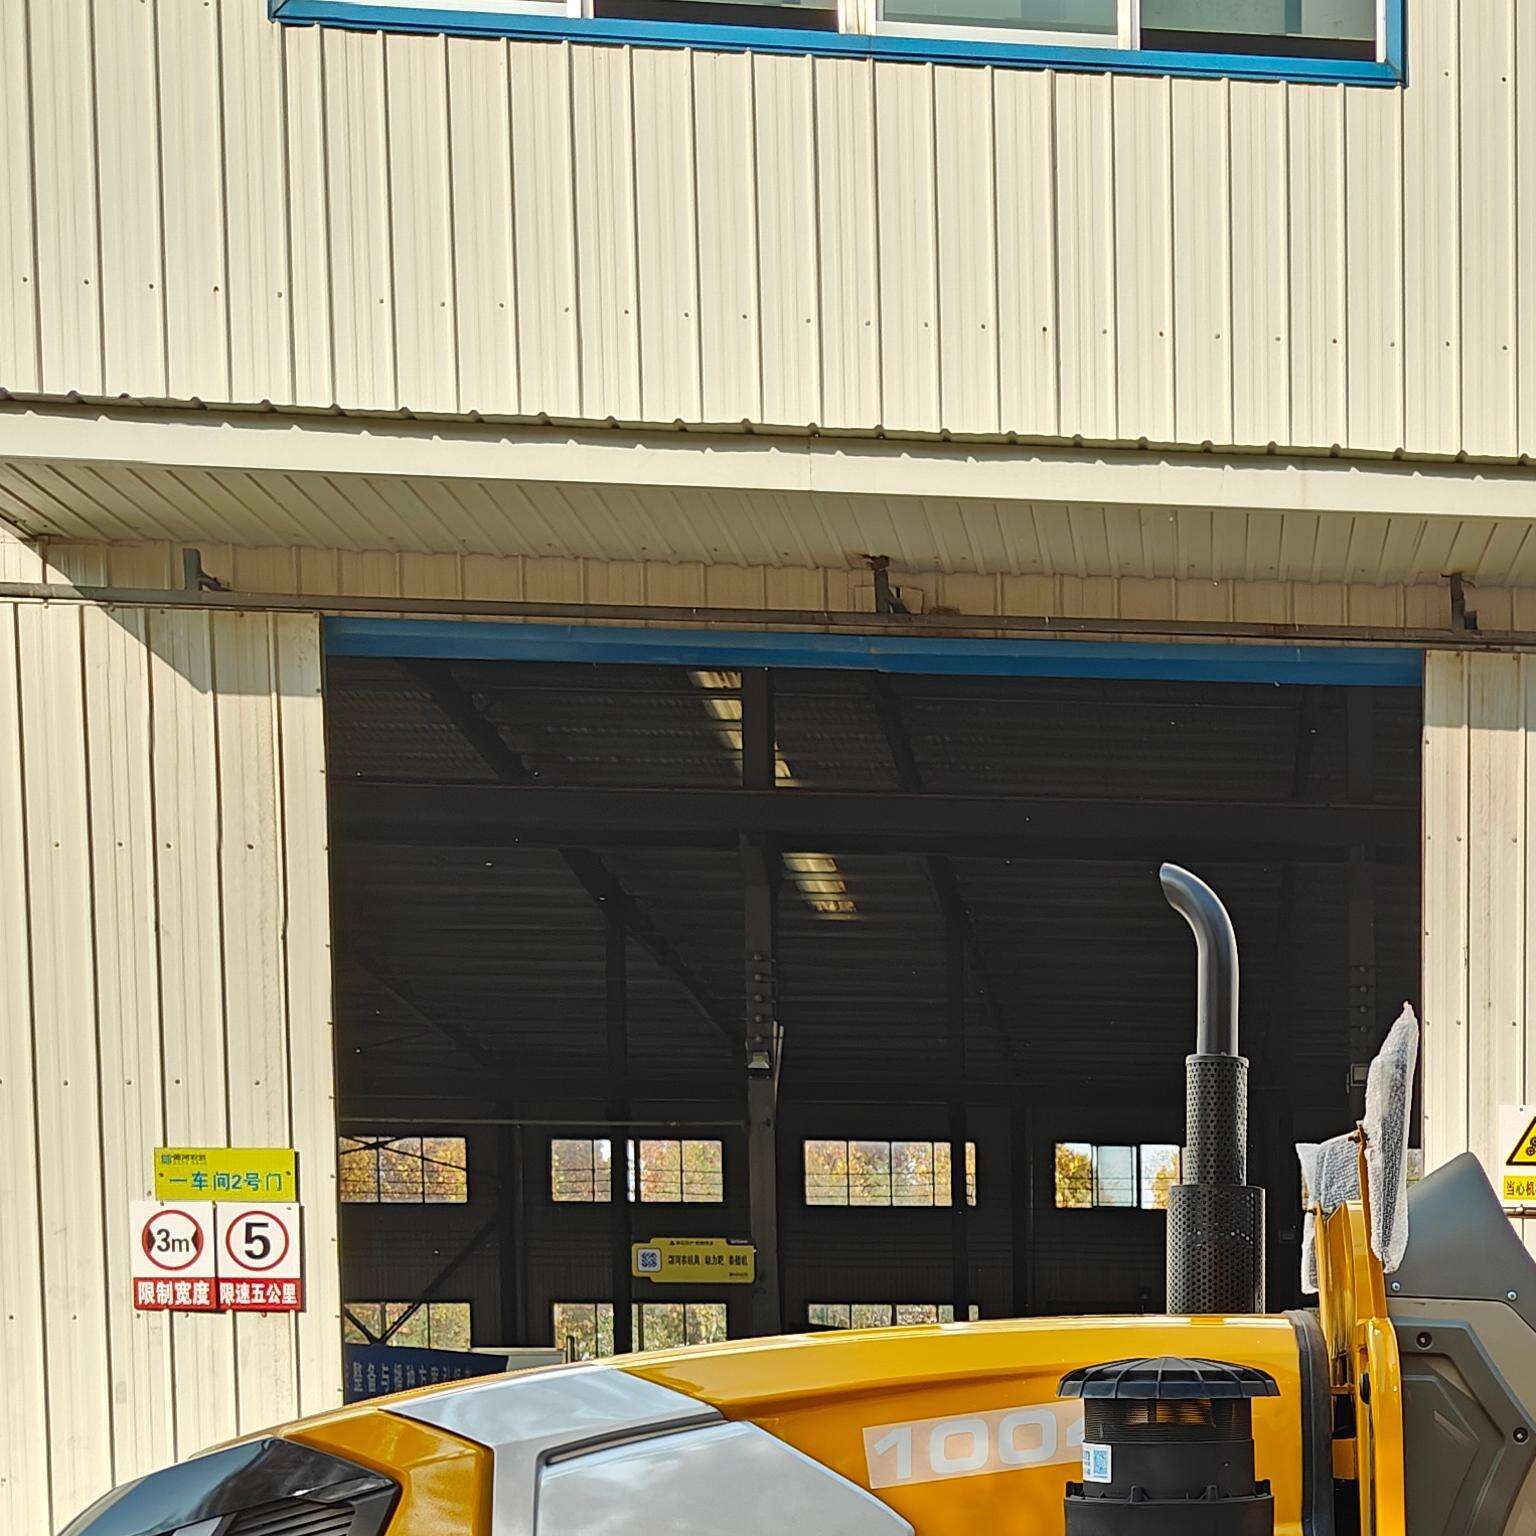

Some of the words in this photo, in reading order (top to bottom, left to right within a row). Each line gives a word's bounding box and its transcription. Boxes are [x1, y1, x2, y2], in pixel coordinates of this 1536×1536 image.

[156, 1228, 190, 1253] 3m
[244, 1222, 271, 1260] 5
[137, 1280, 210, 1306] 限制宽度
[219, 1282, 298, 1305] 限速五公里
[873, 1408, 1085, 1480] 100
